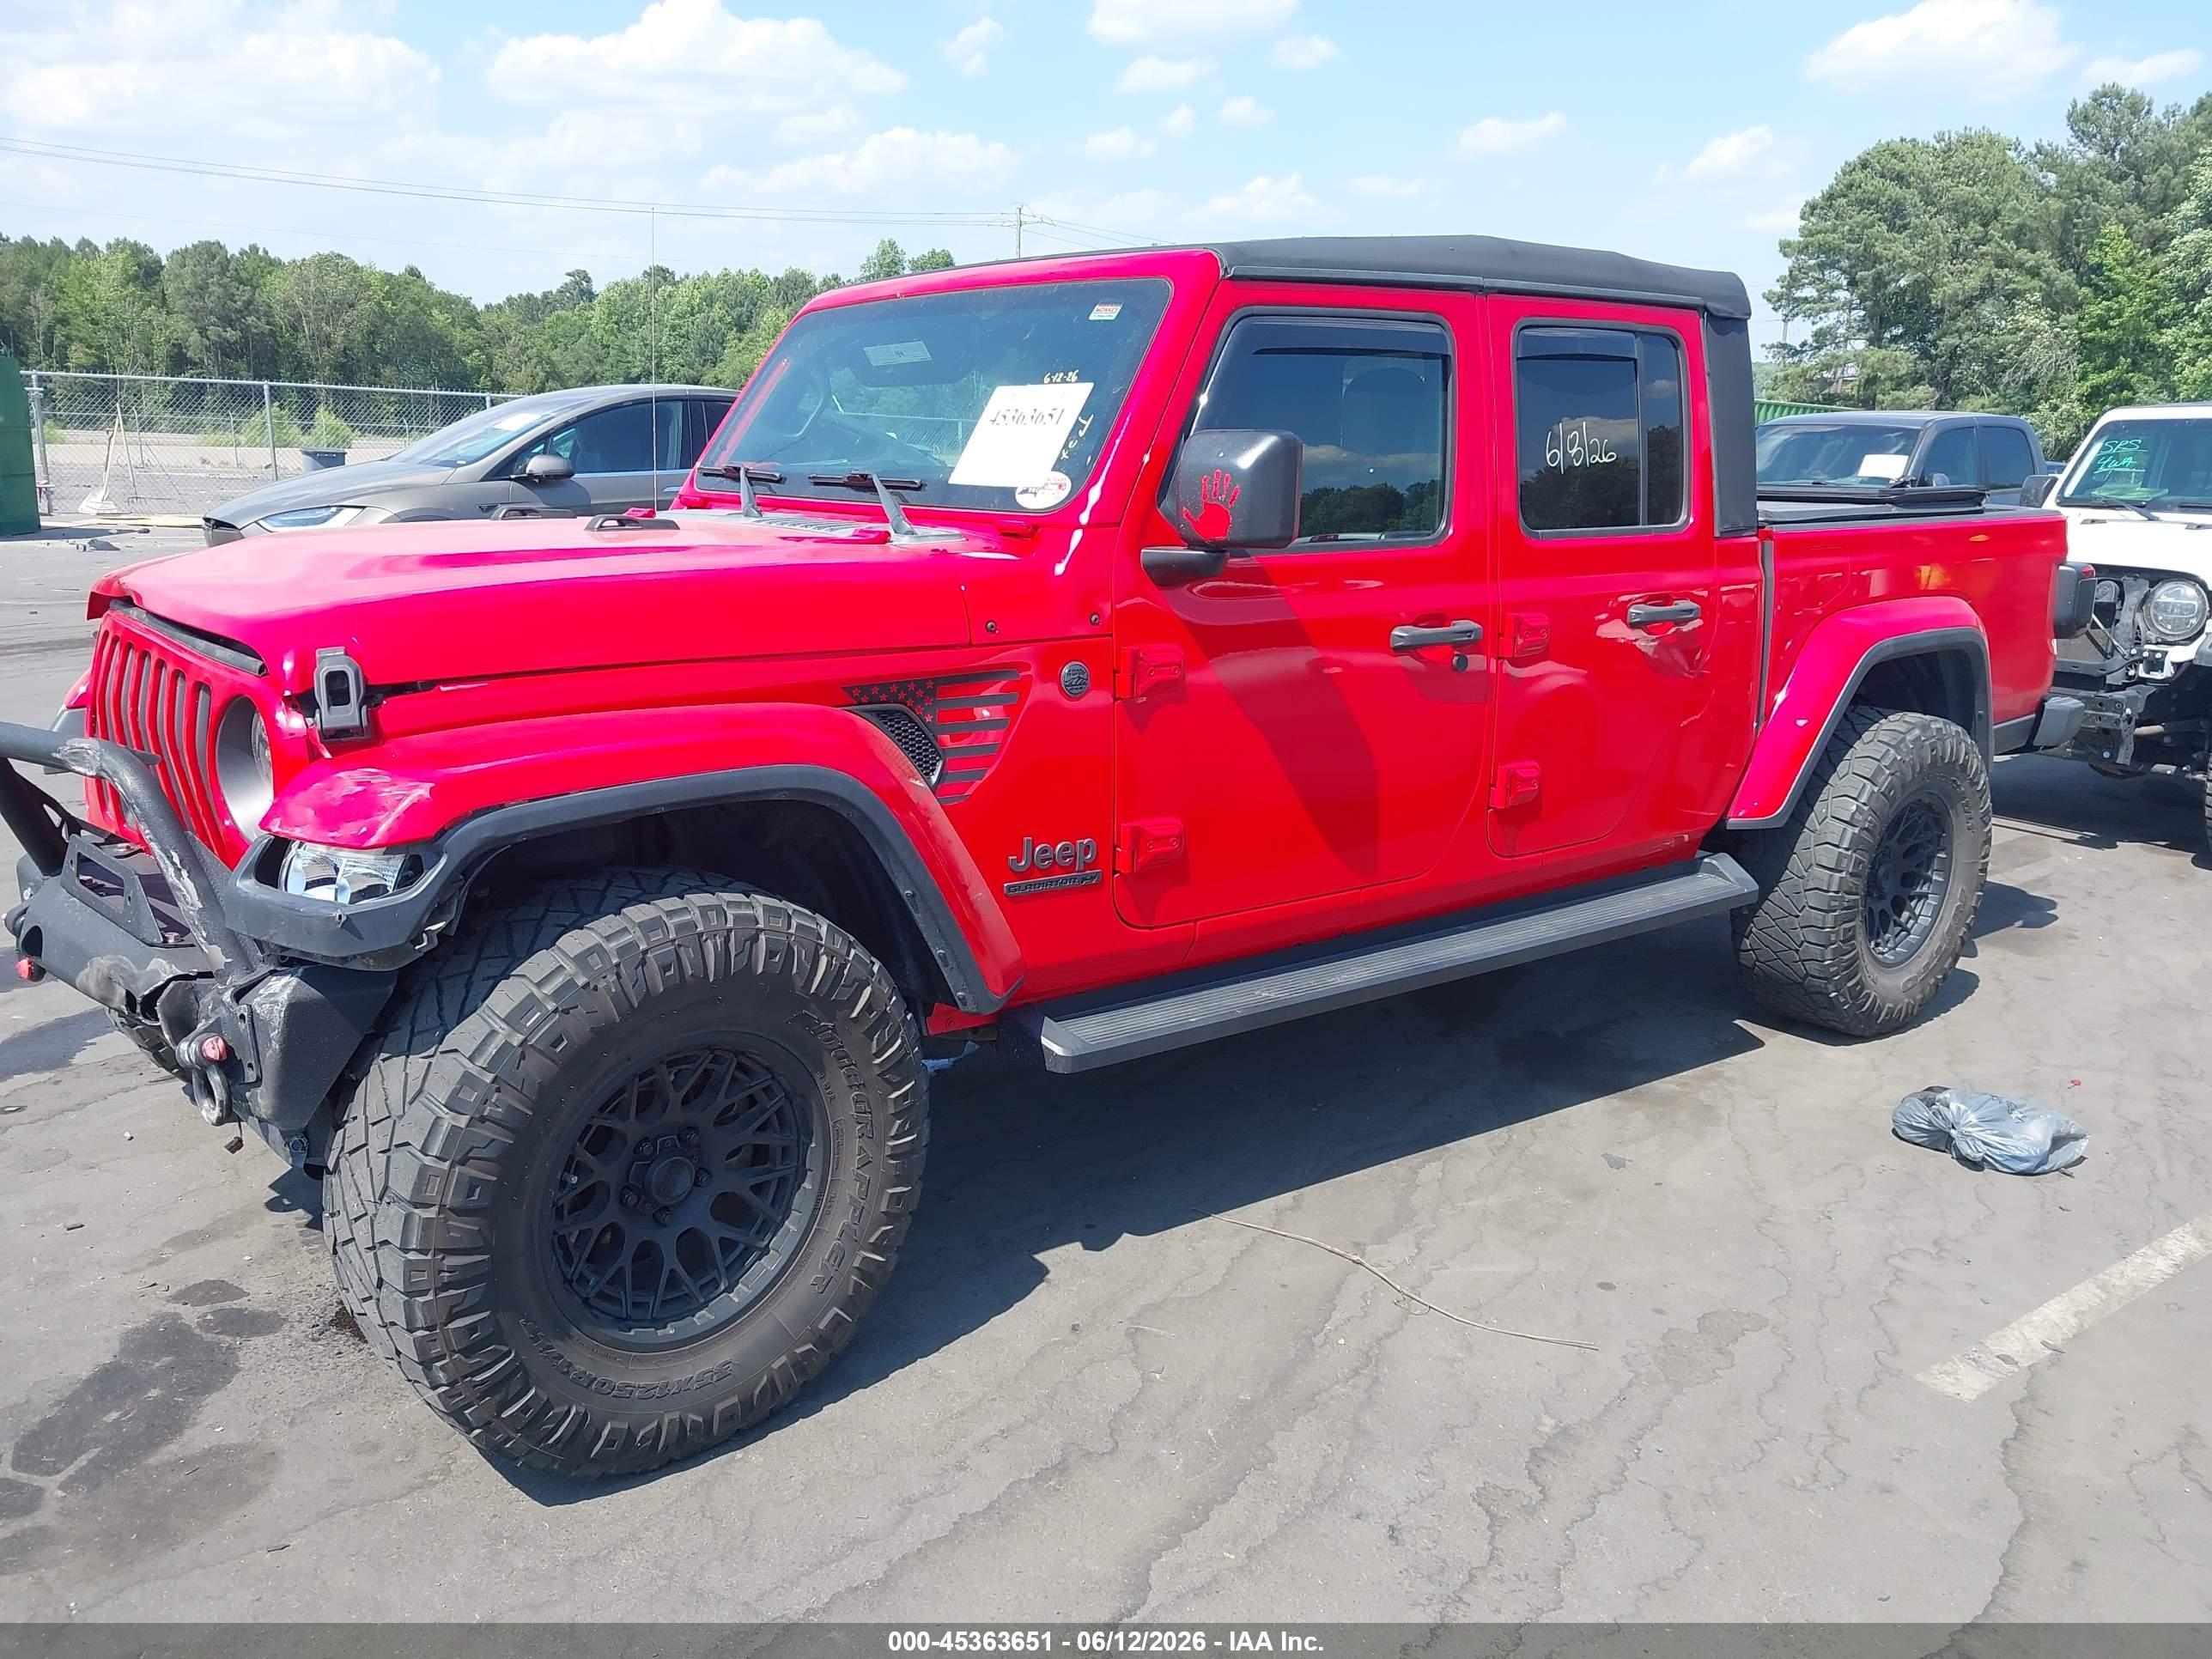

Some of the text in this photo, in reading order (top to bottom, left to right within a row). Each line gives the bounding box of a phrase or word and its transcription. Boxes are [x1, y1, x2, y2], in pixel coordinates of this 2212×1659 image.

[1043, 369, 1079, 384] 6-12-26
[1008, 836, 1097, 872] Jeep
[810, 1091, 873, 1294] GRAPPLER
